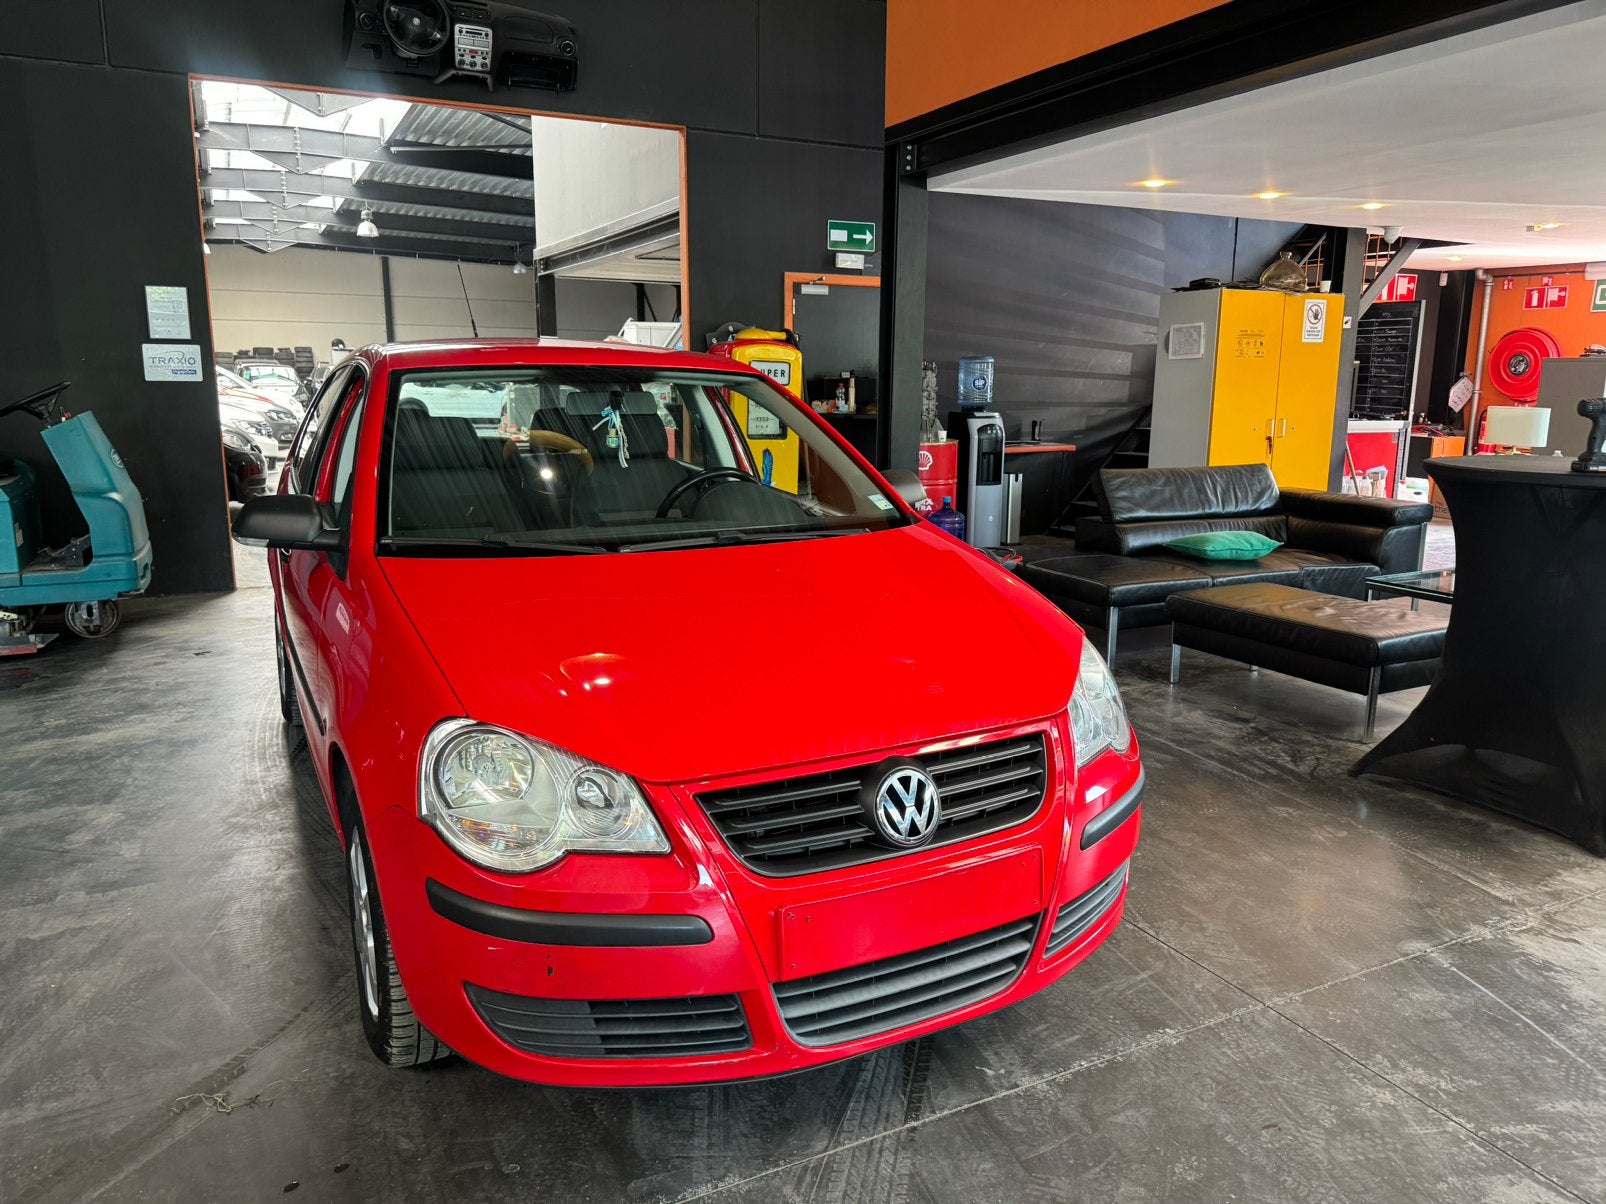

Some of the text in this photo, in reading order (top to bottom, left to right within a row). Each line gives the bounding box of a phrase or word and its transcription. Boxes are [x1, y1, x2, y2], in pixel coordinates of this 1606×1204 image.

[149, 356, 196, 365] TRAXIO
[760, 368, 785, 377] UPER
[877, 769, 939, 842] VW
